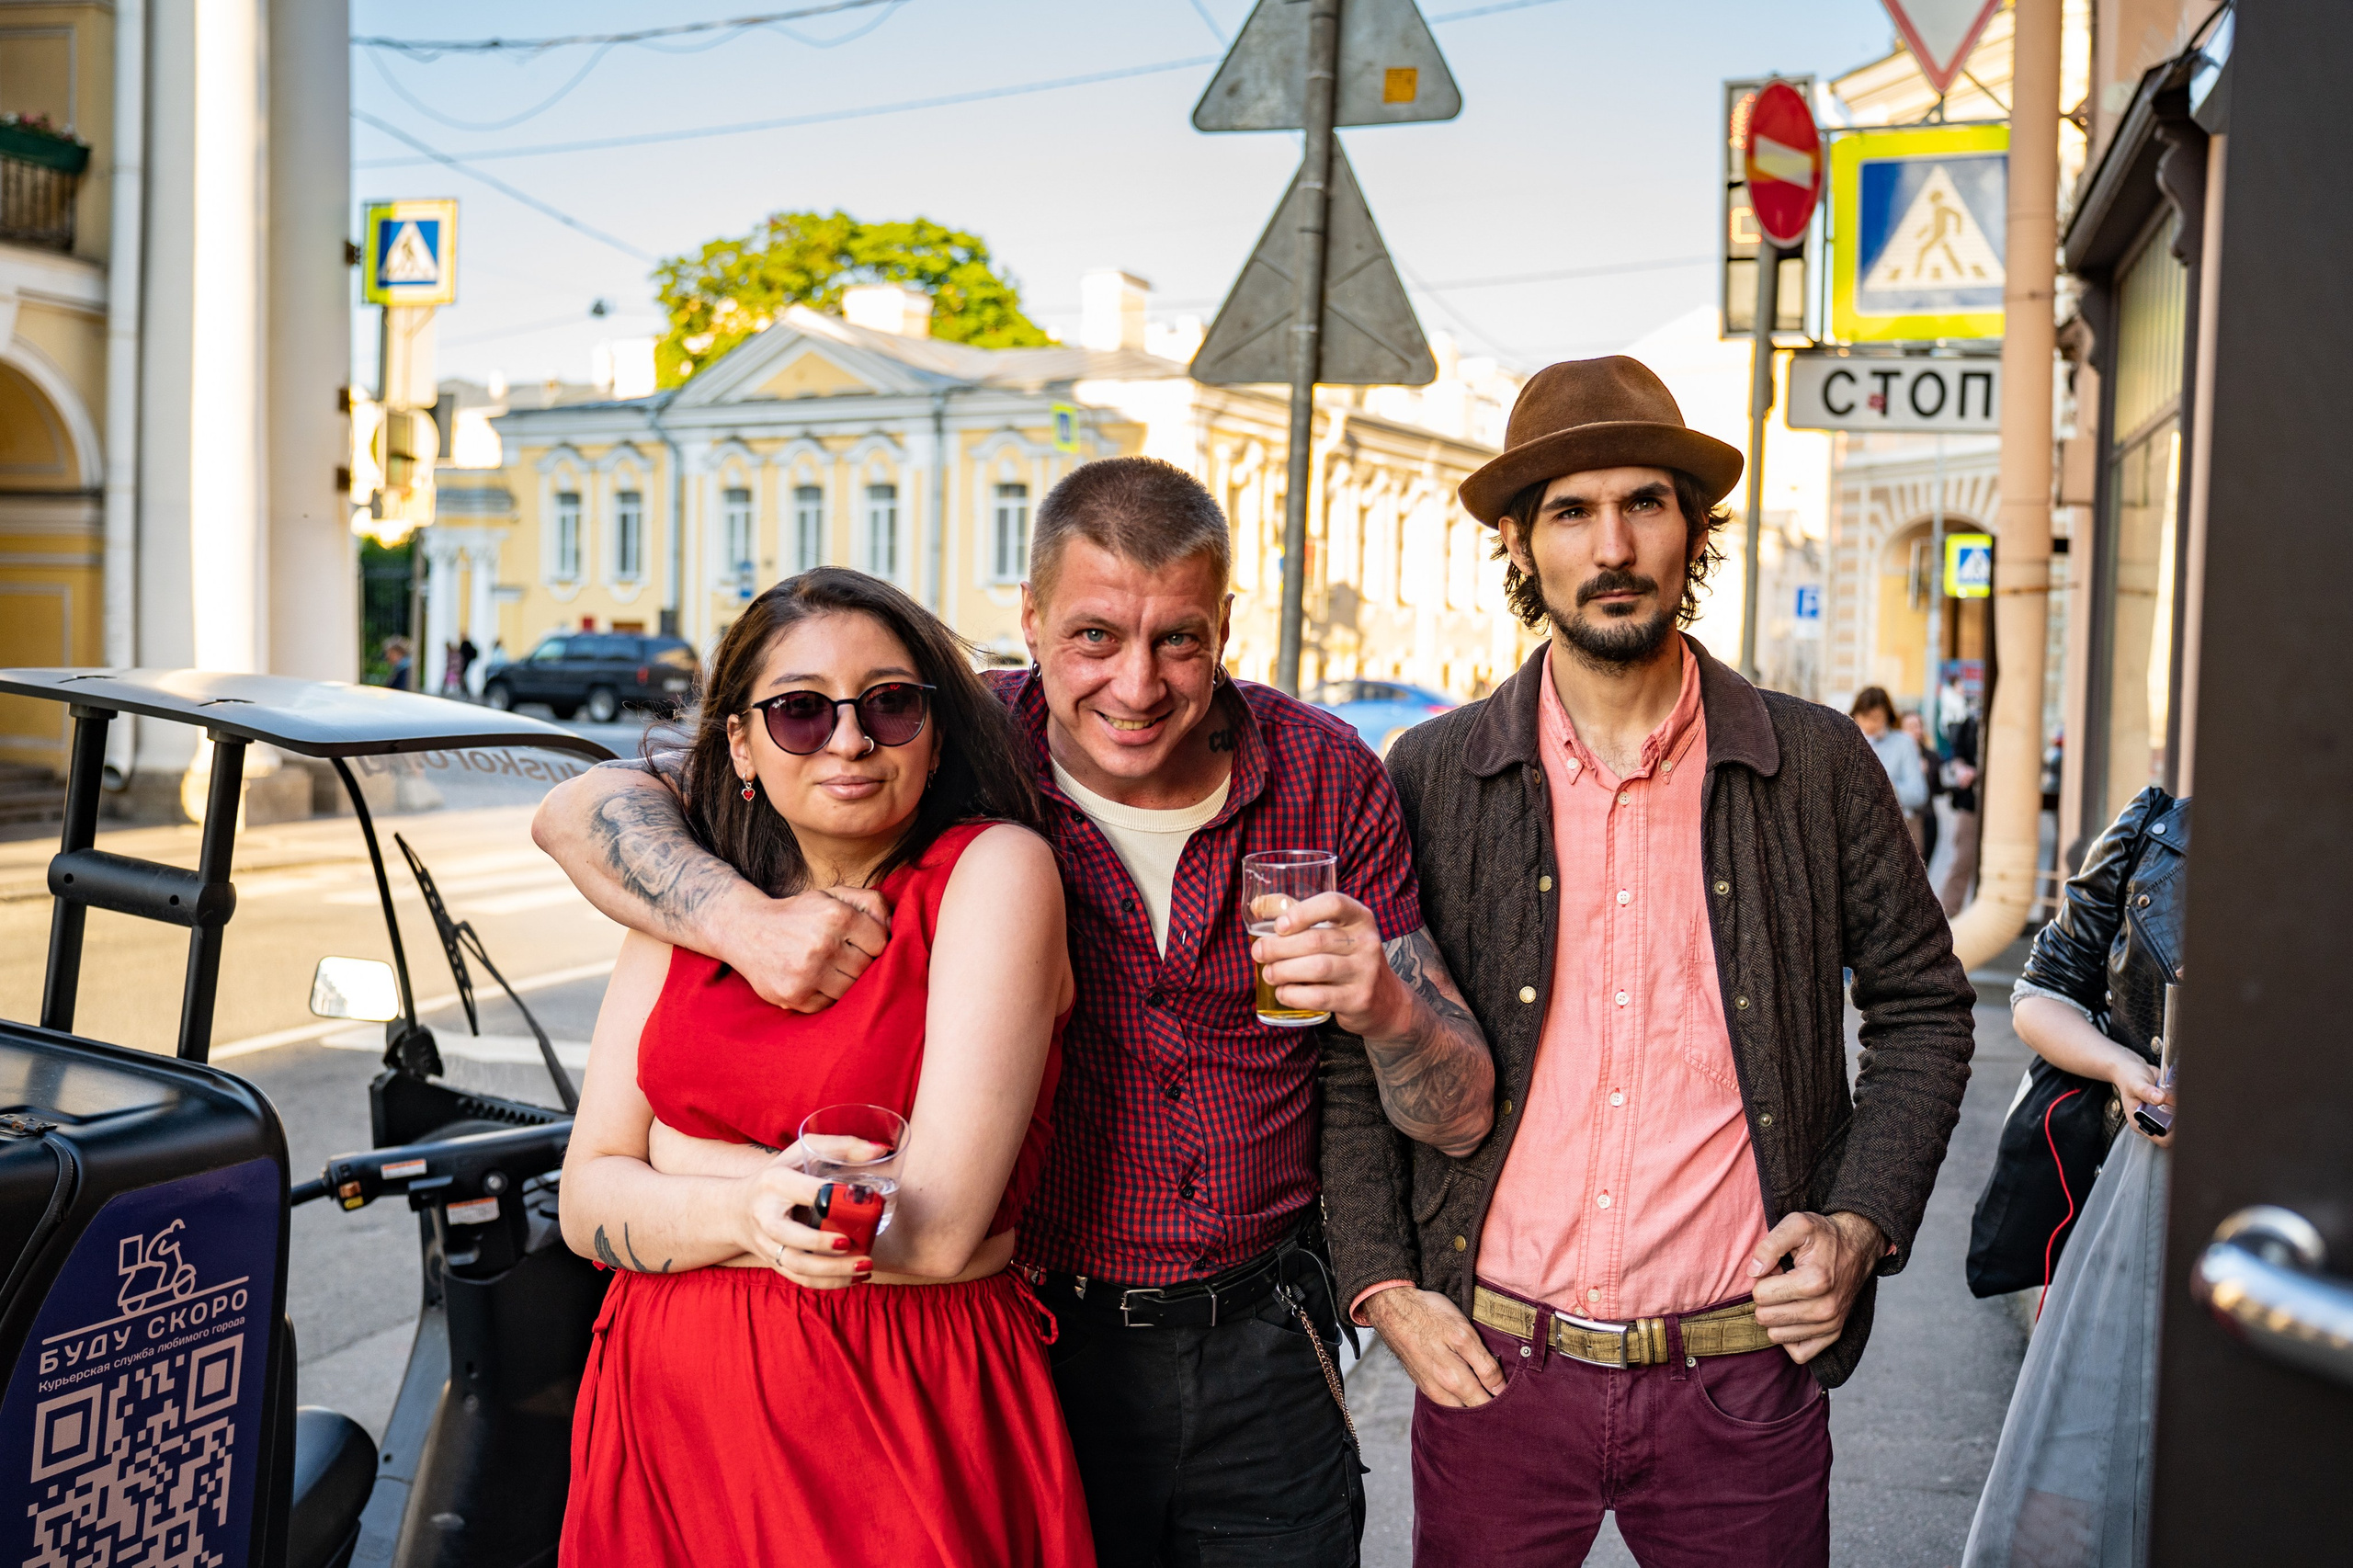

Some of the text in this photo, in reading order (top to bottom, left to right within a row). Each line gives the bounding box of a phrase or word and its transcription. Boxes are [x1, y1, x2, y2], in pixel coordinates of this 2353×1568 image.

[1823, 369, 1992, 417] СТОП
[39, 1316, 245, 1392] Курьерская служба любимого города
[40, 1289, 248, 1375] БУДУ СКОРО
